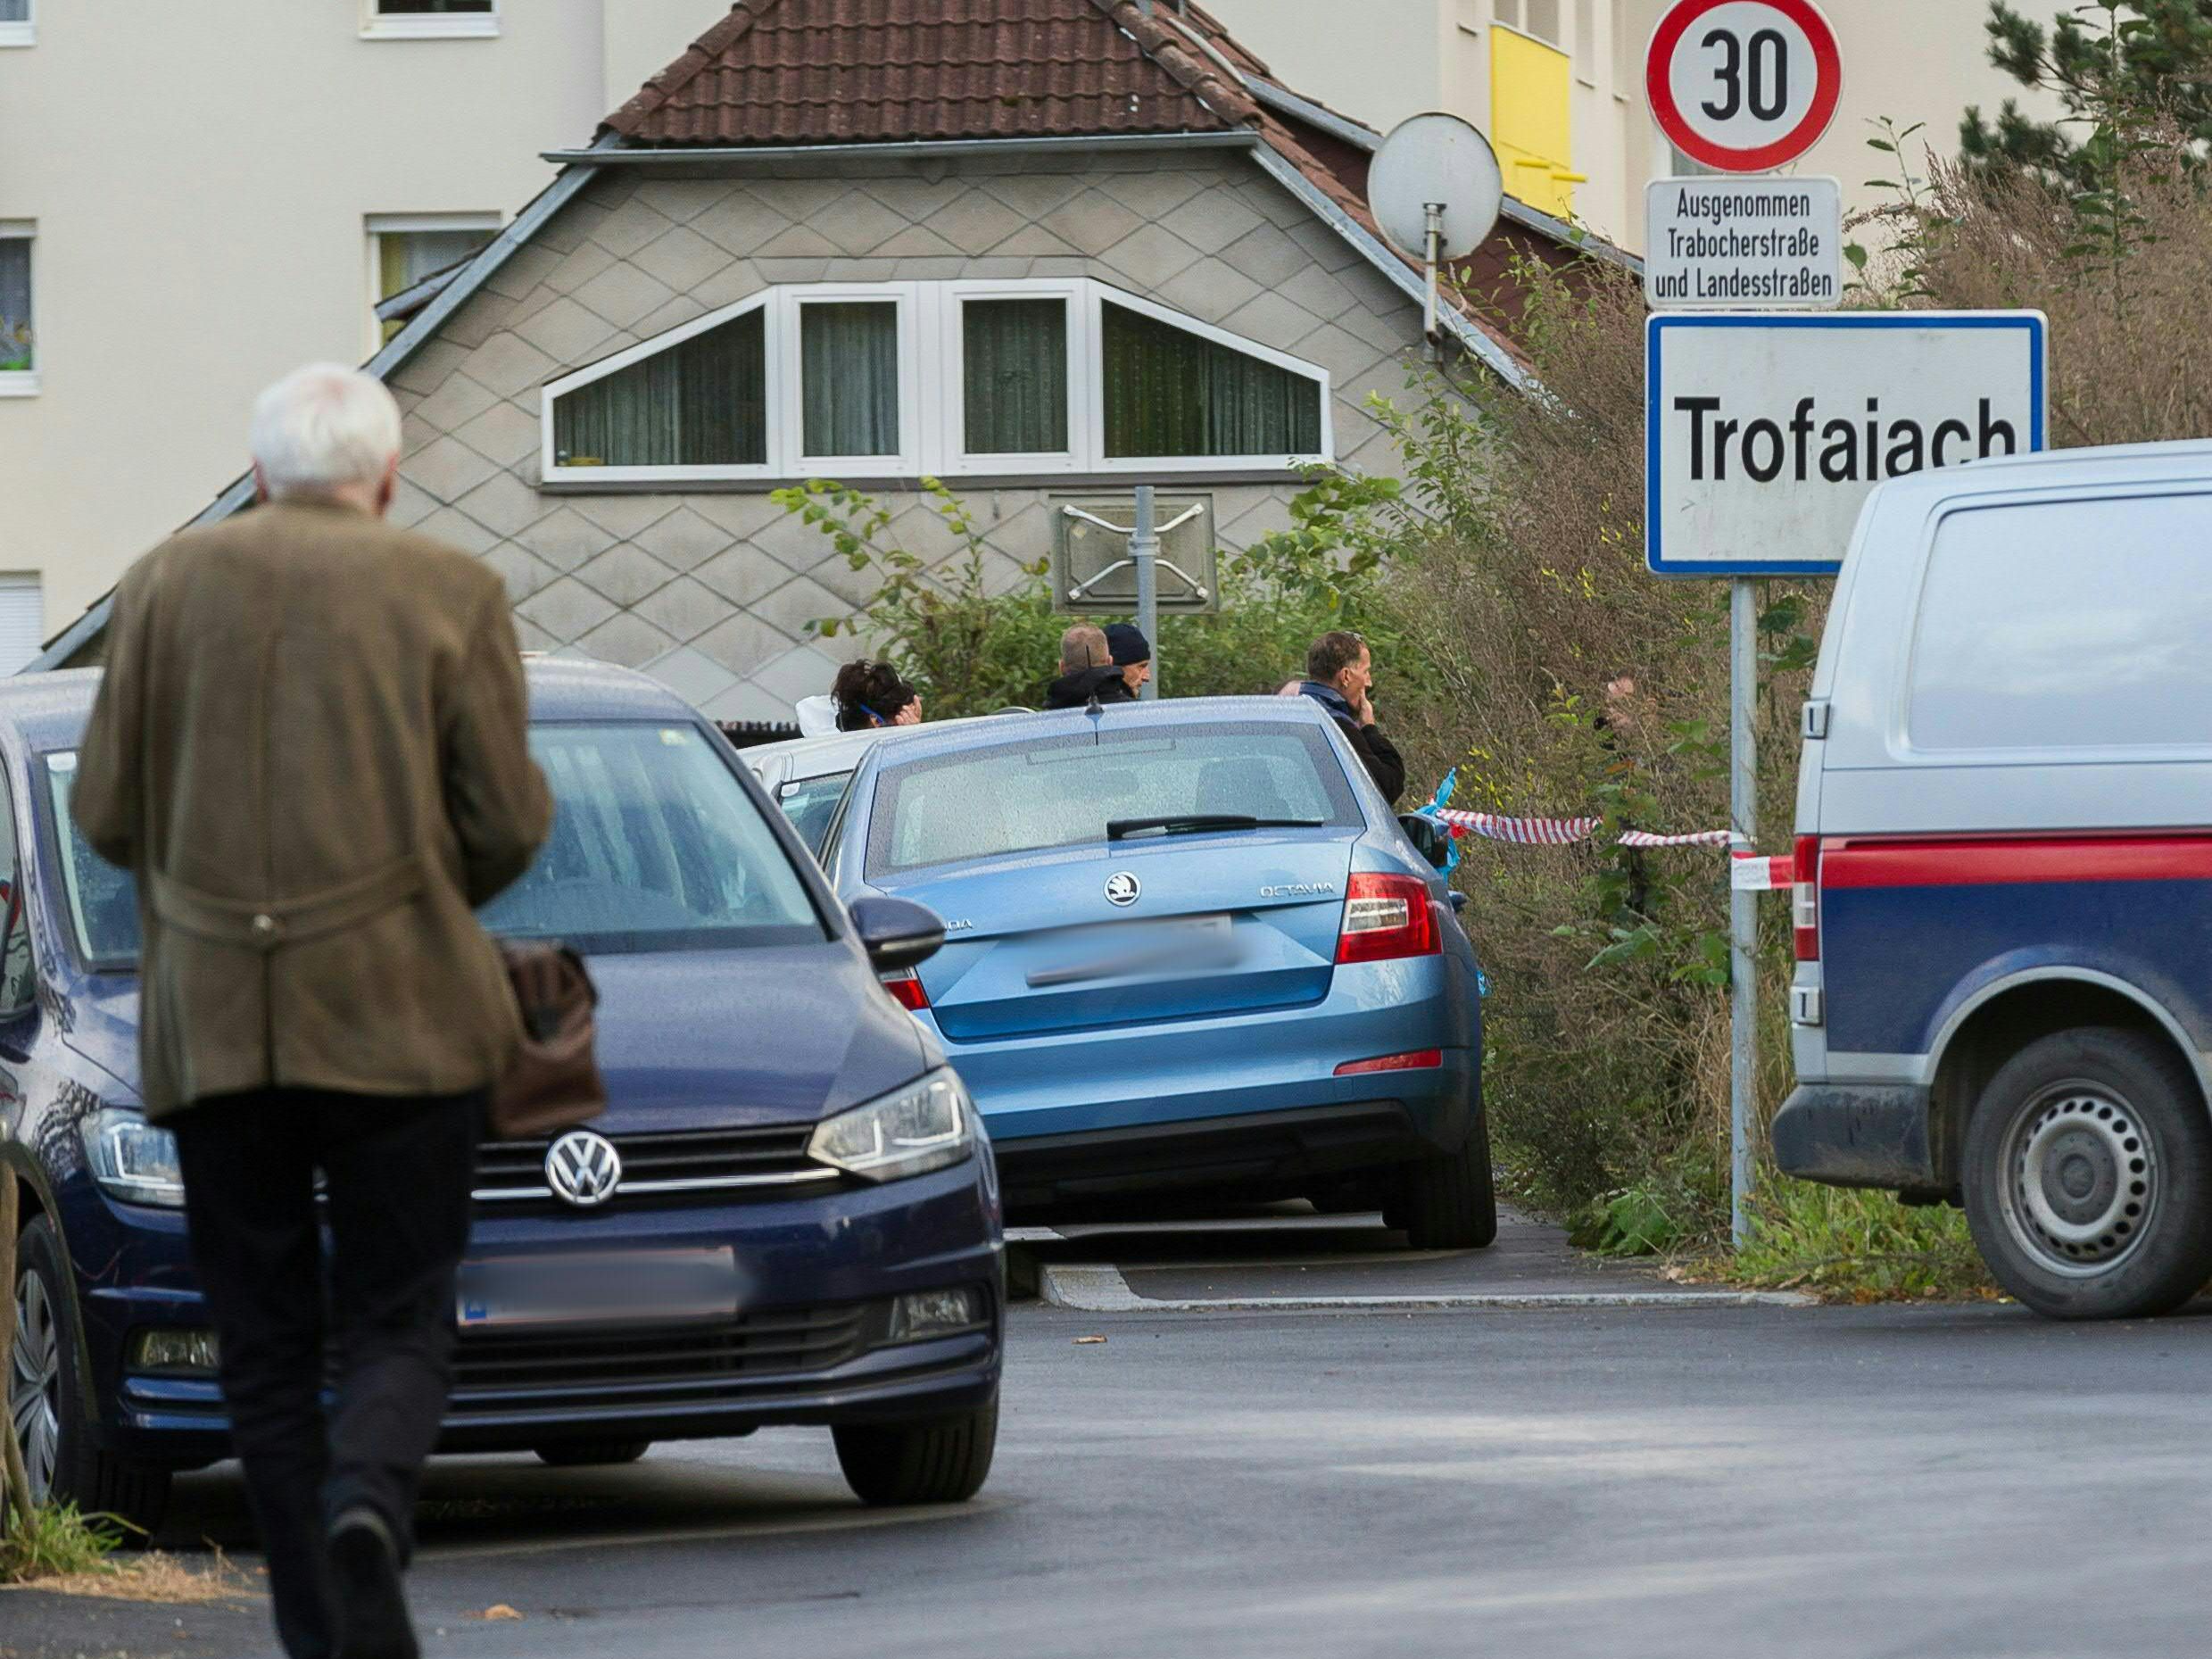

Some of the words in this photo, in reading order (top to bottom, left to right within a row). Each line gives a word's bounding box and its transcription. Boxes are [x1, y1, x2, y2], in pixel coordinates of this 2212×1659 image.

[1701, 29, 1788, 121] 30
[1677, 187, 1810, 226] Ausgenommen
[1668, 227, 1819, 258] Trabocherstraße
[1655, 267, 1688, 298] und
[1696, 266, 1832, 298] Landesstraßen
[1674, 396, 2016, 483] Trofaiach
[1260, 882, 1335, 898] OCTAVIA
